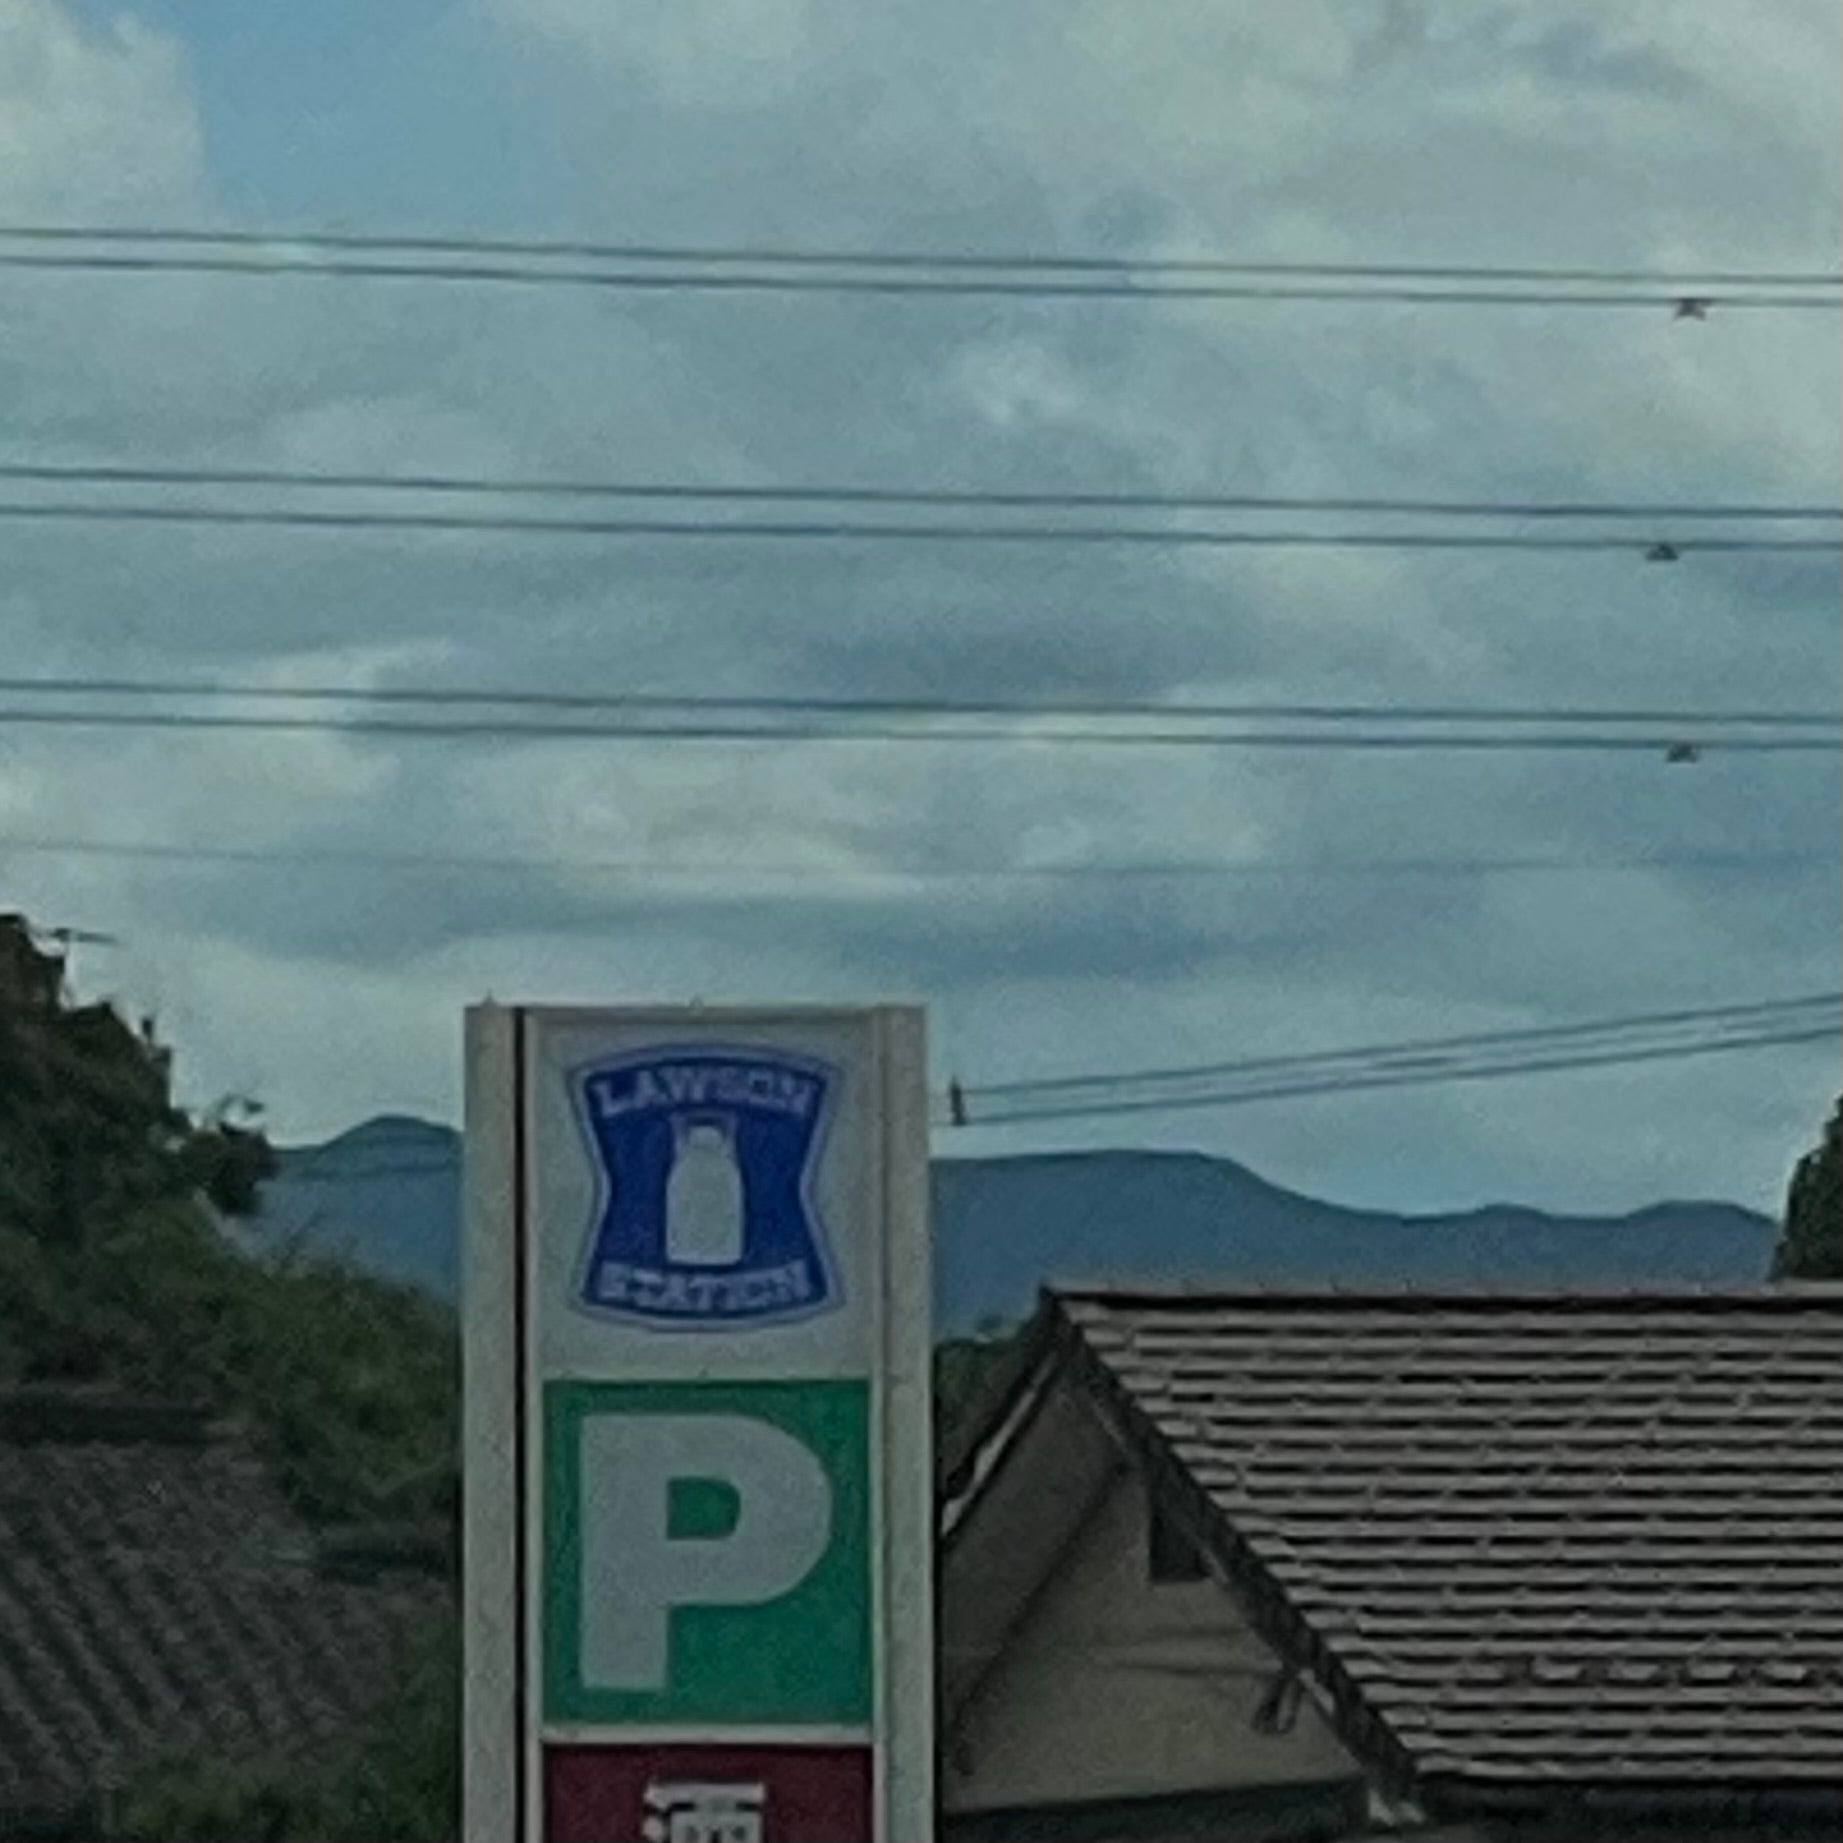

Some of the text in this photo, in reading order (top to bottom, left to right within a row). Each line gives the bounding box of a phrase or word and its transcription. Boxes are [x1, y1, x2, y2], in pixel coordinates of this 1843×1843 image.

[594, 1064, 815, 1117] LAWSON
[597, 1258, 812, 1311] STATION
[580, 1414, 833, 1691] P
